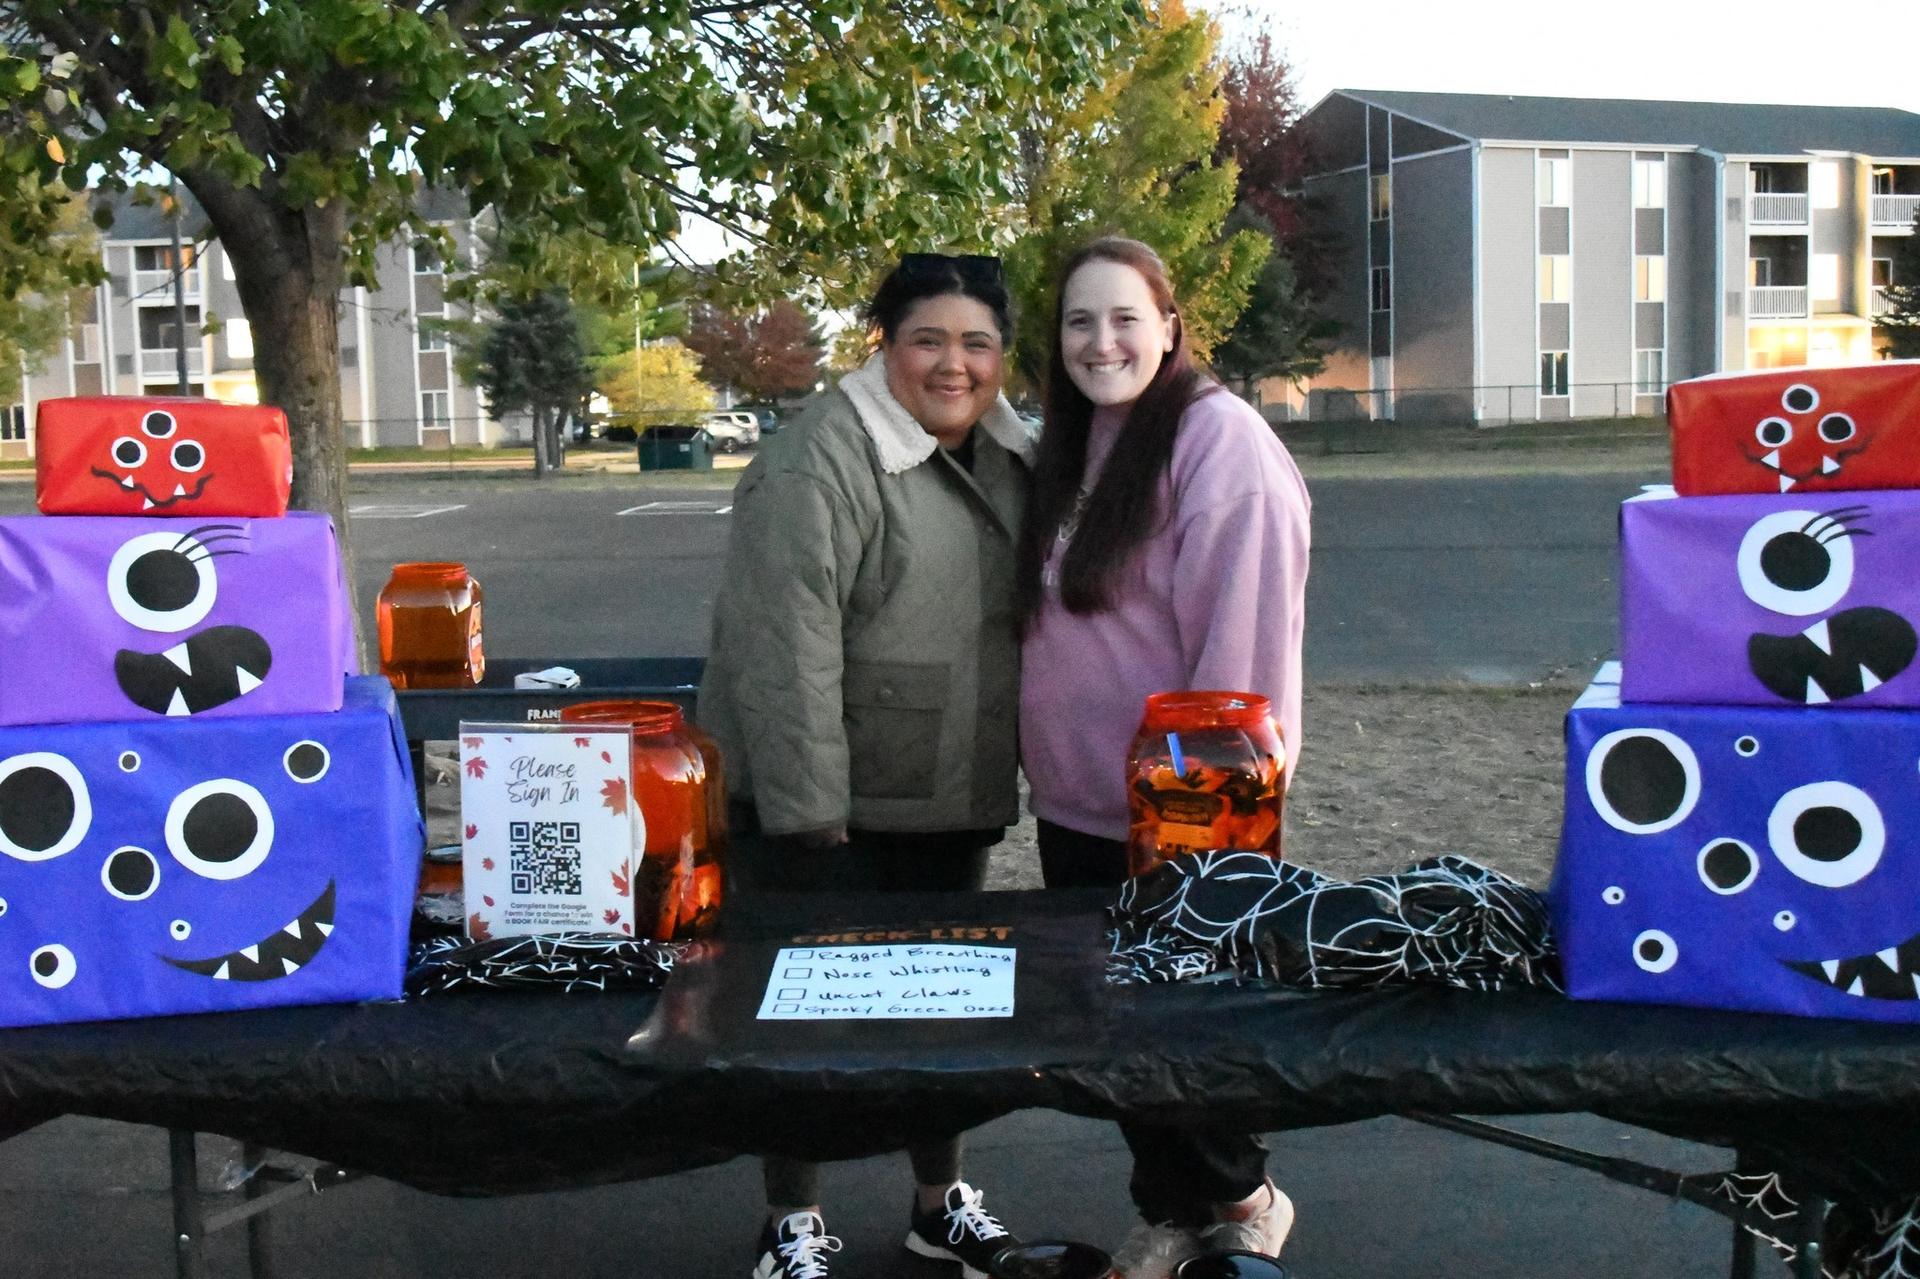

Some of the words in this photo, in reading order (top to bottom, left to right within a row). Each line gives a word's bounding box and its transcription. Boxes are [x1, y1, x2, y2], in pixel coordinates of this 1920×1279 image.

[510, 756, 576, 779] Please
[505, 779, 550, 808] Sign
[560, 780, 579, 804] In
[510, 902, 546, 910] Complete
[561, 903, 587, 911] Google
[818, 948, 892, 962] Ragged
[907, 947, 1011, 962] Breathing
[824, 968, 873, 980] Nose
[889, 965, 991, 977] Whistling
[804, 1005, 873, 1015] Spooky
[888, 1004, 949, 1014] Green
